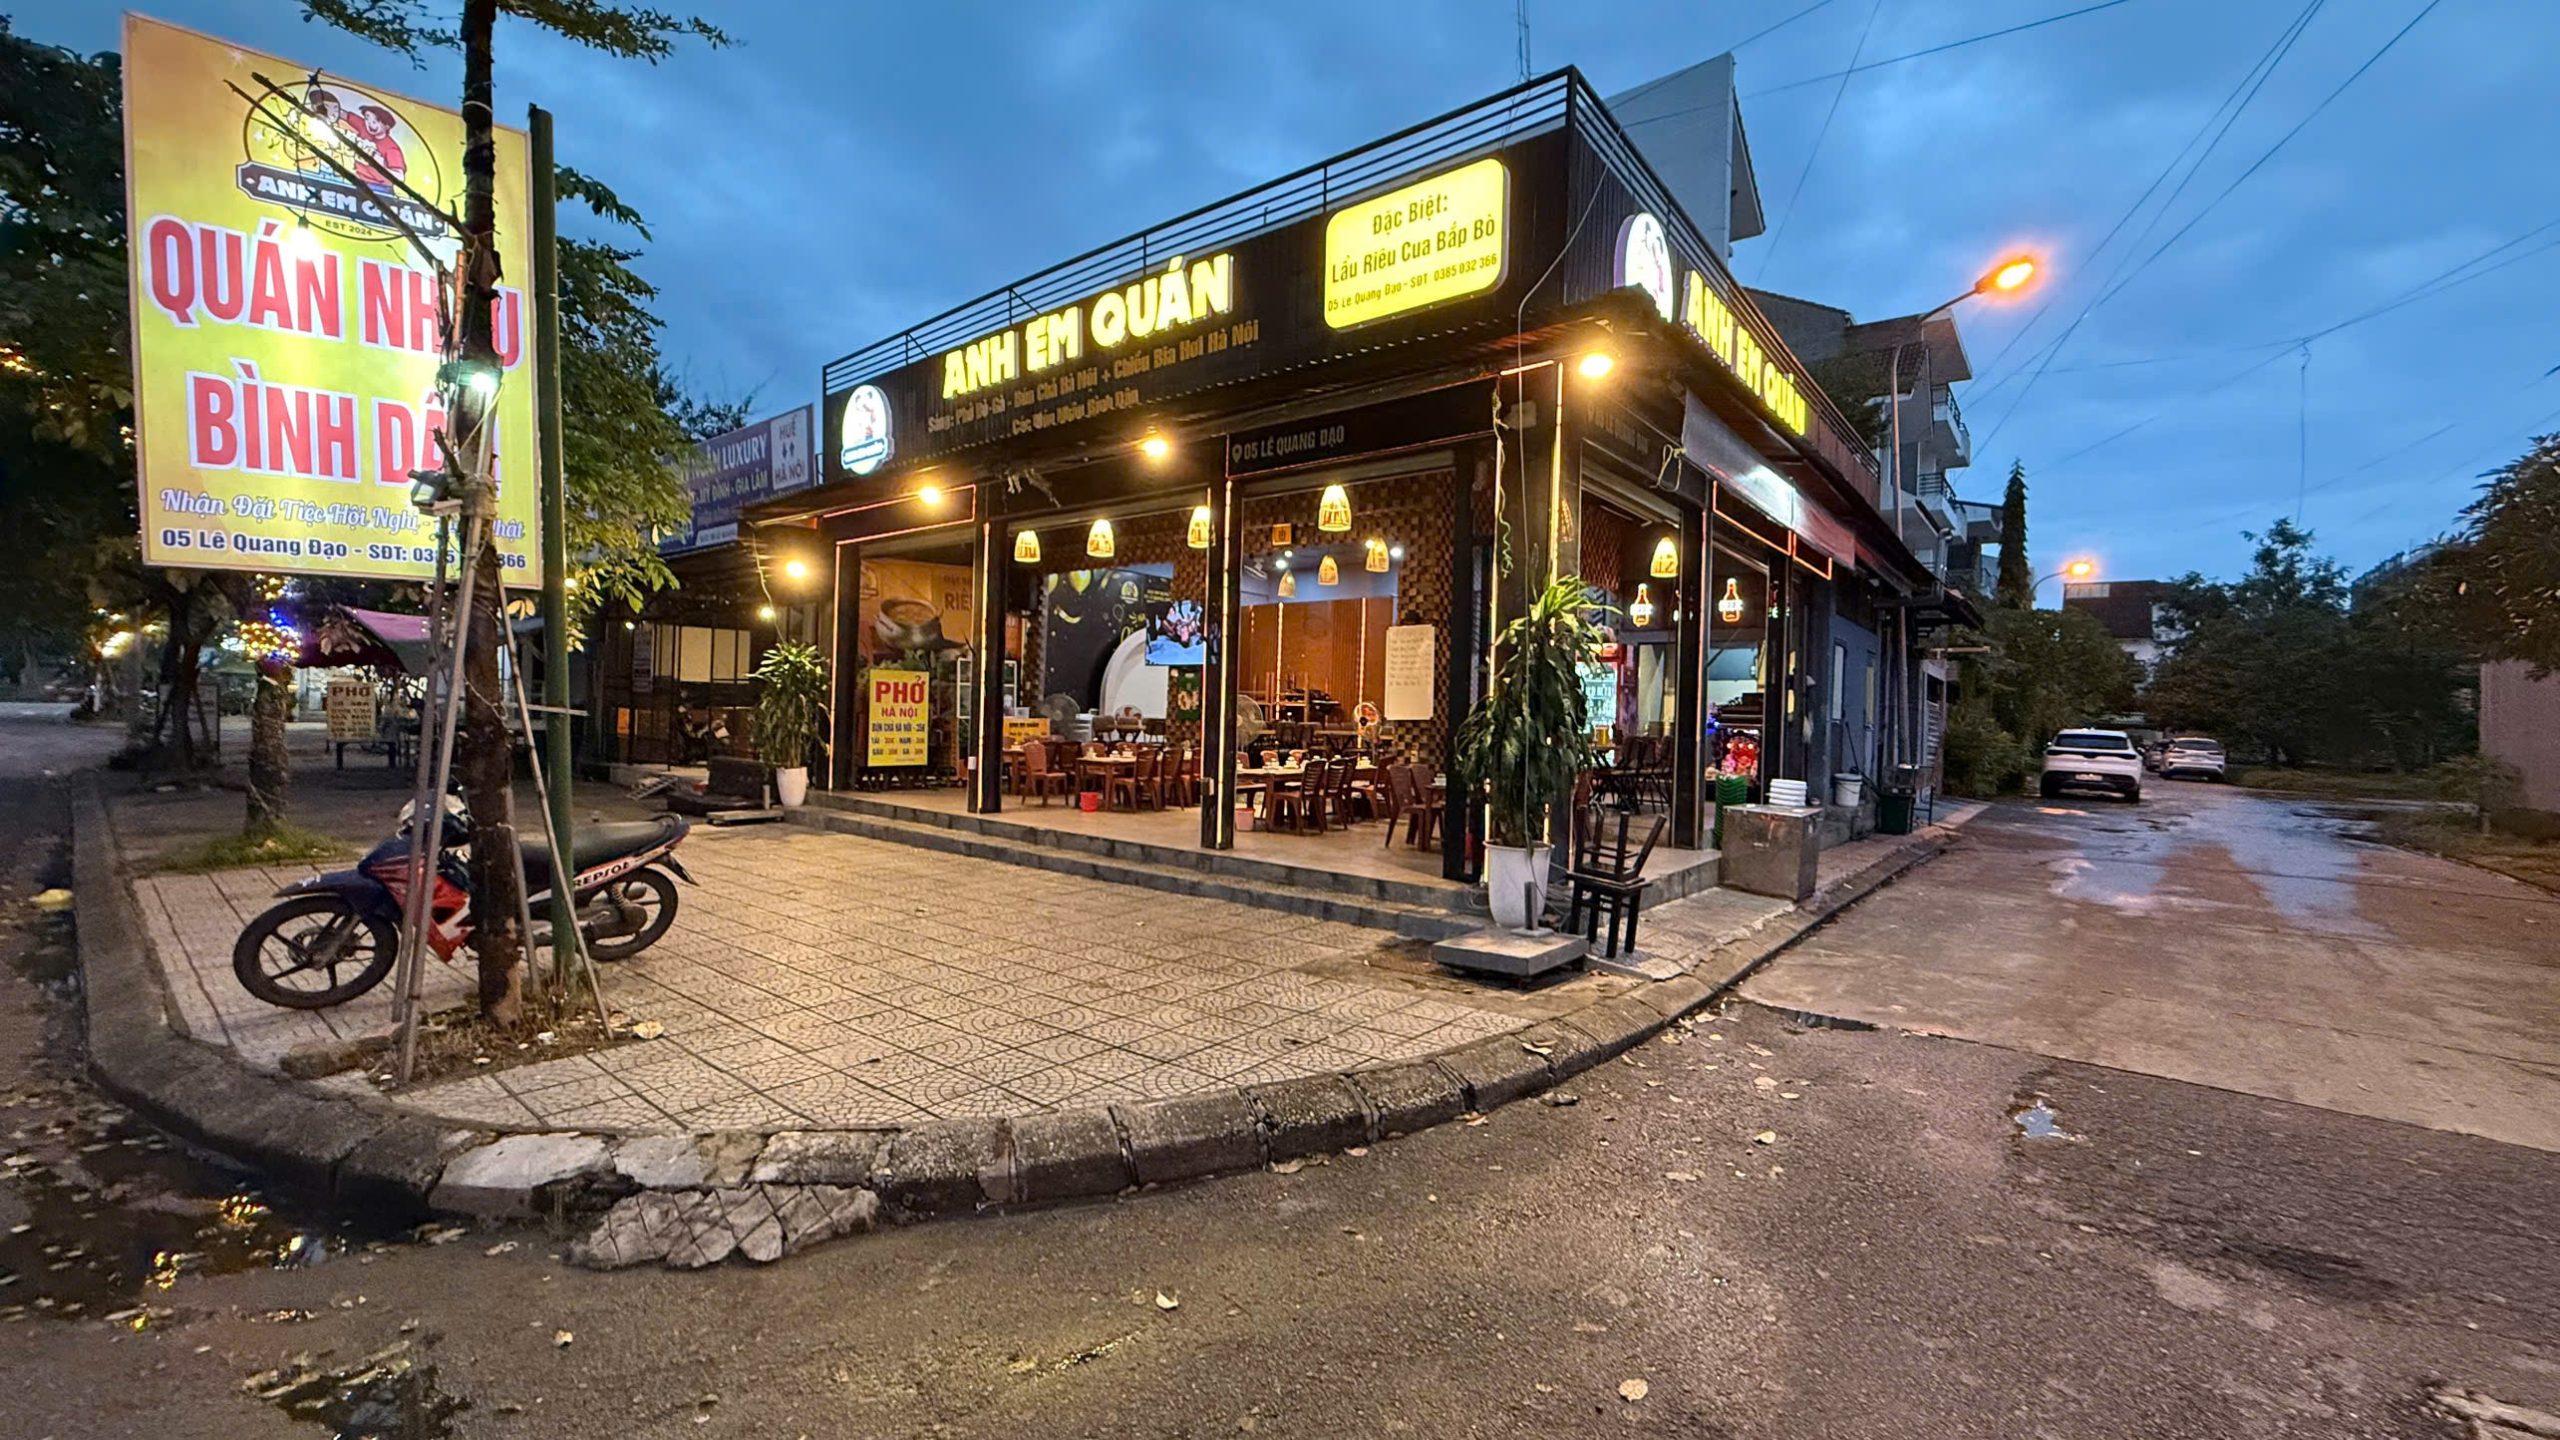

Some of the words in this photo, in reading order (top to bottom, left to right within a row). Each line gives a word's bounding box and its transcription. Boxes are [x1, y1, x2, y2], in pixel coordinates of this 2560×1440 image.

[320, 189, 358, 213] EM
[1373, 210, 1402, 235] Đặc
[1408, 193, 1448, 223] Biệt:
[325, 220, 346, 231] EST
[349, 224, 373, 237] 2024
[1332, 254, 1358, 284] Lẩu
[1363, 248, 1396, 275] Riêu
[1401, 237, 1431, 262] Cua
[1436, 220, 1467, 252] Bắp
[1473, 213, 1496, 241] Bò
[148, 218, 341, 339] QUÁN
[362, 260, 523, 369] NHU
[1328, 299, 1339, 312] 05
[1355, 288, 1382, 305] Quang
[1433, 265, 1457, 281] 0385
[1459, 259, 1477, 276] 032
[1479, 253, 1498, 270] 366
[942, 330, 1017, 399] ANH
[1025, 308, 1081, 373] EM
[1090, 254, 1233, 347] QUÁN
[1153, 345, 1176, 369] Bia
[1207, 327, 1228, 354] Hà
[1231, 319, 1259, 348] Nội
[1686, 269, 1734, 367] ANH
[1736, 322, 1763, 397] EM
[1763, 361, 1807, 437] QUÁN
[193, 362, 359, 480] BÌNH
[722, 432, 768, 471] LUXURY
[1243, 442, 1259, 460] 05
[1260, 436, 1275, 457] LÊ
[1276, 431, 1316, 457] QUANG
[1319, 425, 1345, 447] ĐẠO
[774, 463, 788, 485] HÀ
[161, 489, 228, 519] Nhận
[232, 494, 277, 524] Đặt
[280, 499, 326, 527] Tiệc
[327, 503, 371, 531] Hội
[162, 529, 191, 547] 05
[199, 532, 225, 549] Lê
[233, 534, 302, 556] Quang
[308, 539, 347, 560] Đạo
[369, 544, 407, 561] SĐT:
[413, 548, 456, 564] 035
[875, 675, 927, 704] PHỞ
[881, 706, 896, 718] HÀ
[899, 707, 918, 719] NỘI
